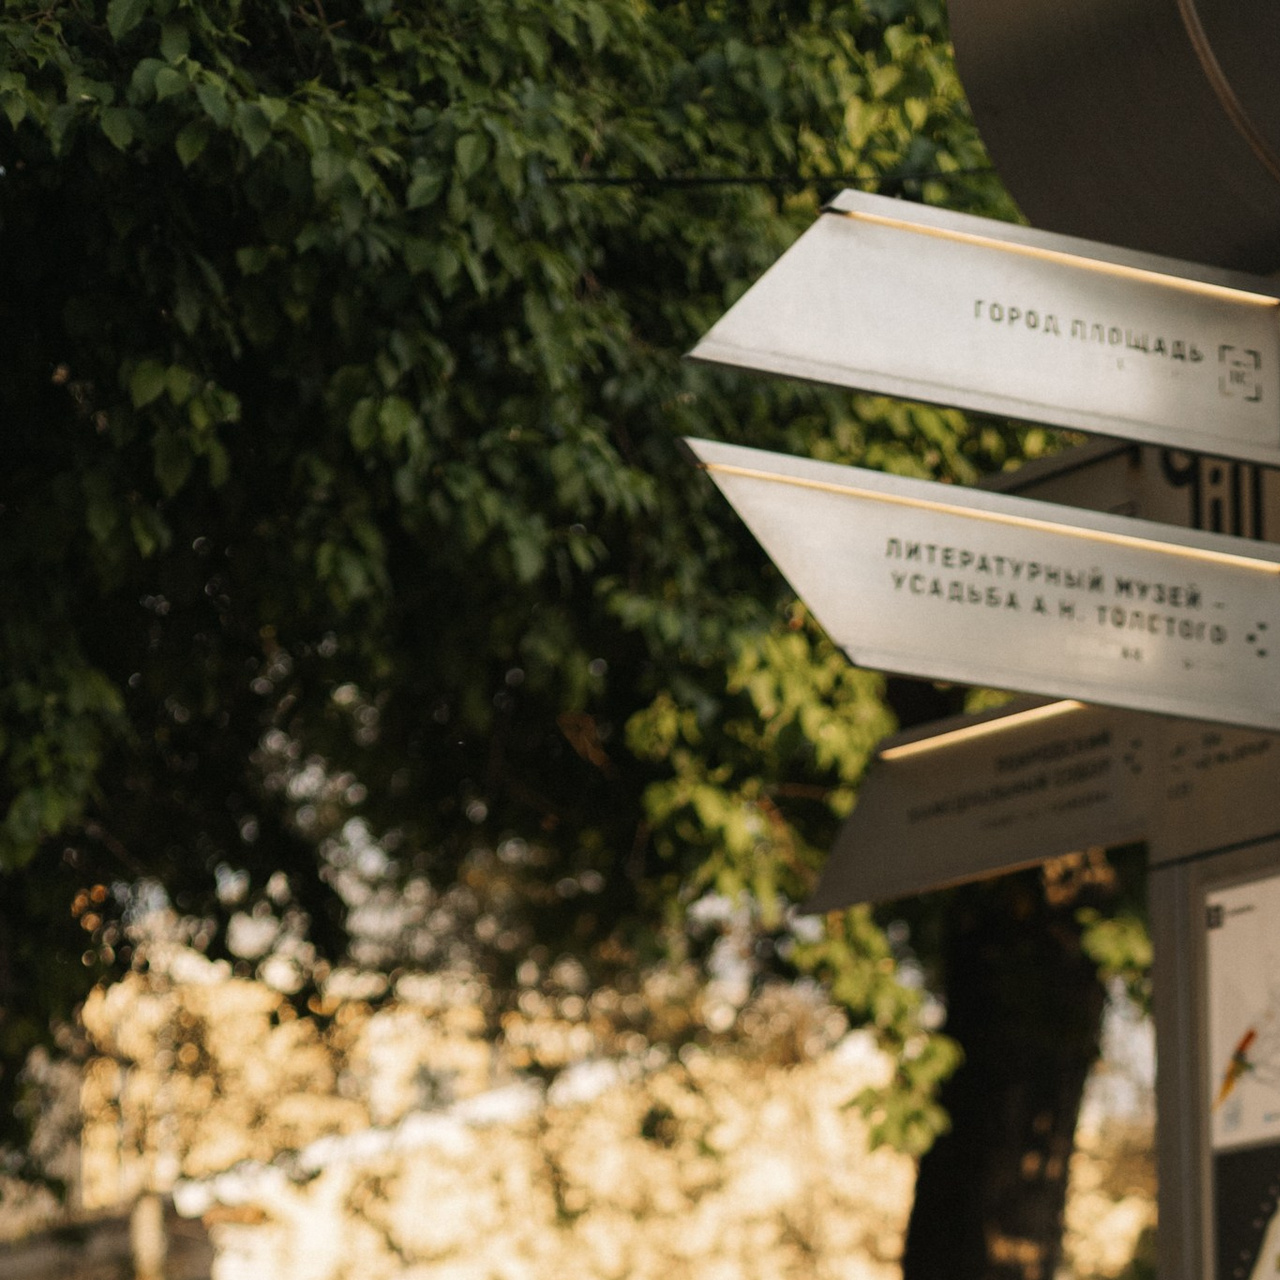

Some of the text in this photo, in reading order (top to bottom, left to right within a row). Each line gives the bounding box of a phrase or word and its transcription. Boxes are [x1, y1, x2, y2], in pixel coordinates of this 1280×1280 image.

[974, 300, 1204, 362] ГОРОД ПЛОЩАДЬ
[886, 538, 1105, 592] ЛИТЕРАТУРНЫЙ
[1115, 577, 1202, 608] МУЗЕЙ
[891, 571, 1020, 610] УСАДЬБА
[1098, 604, 1229, 645] ТОЛСТОГО
